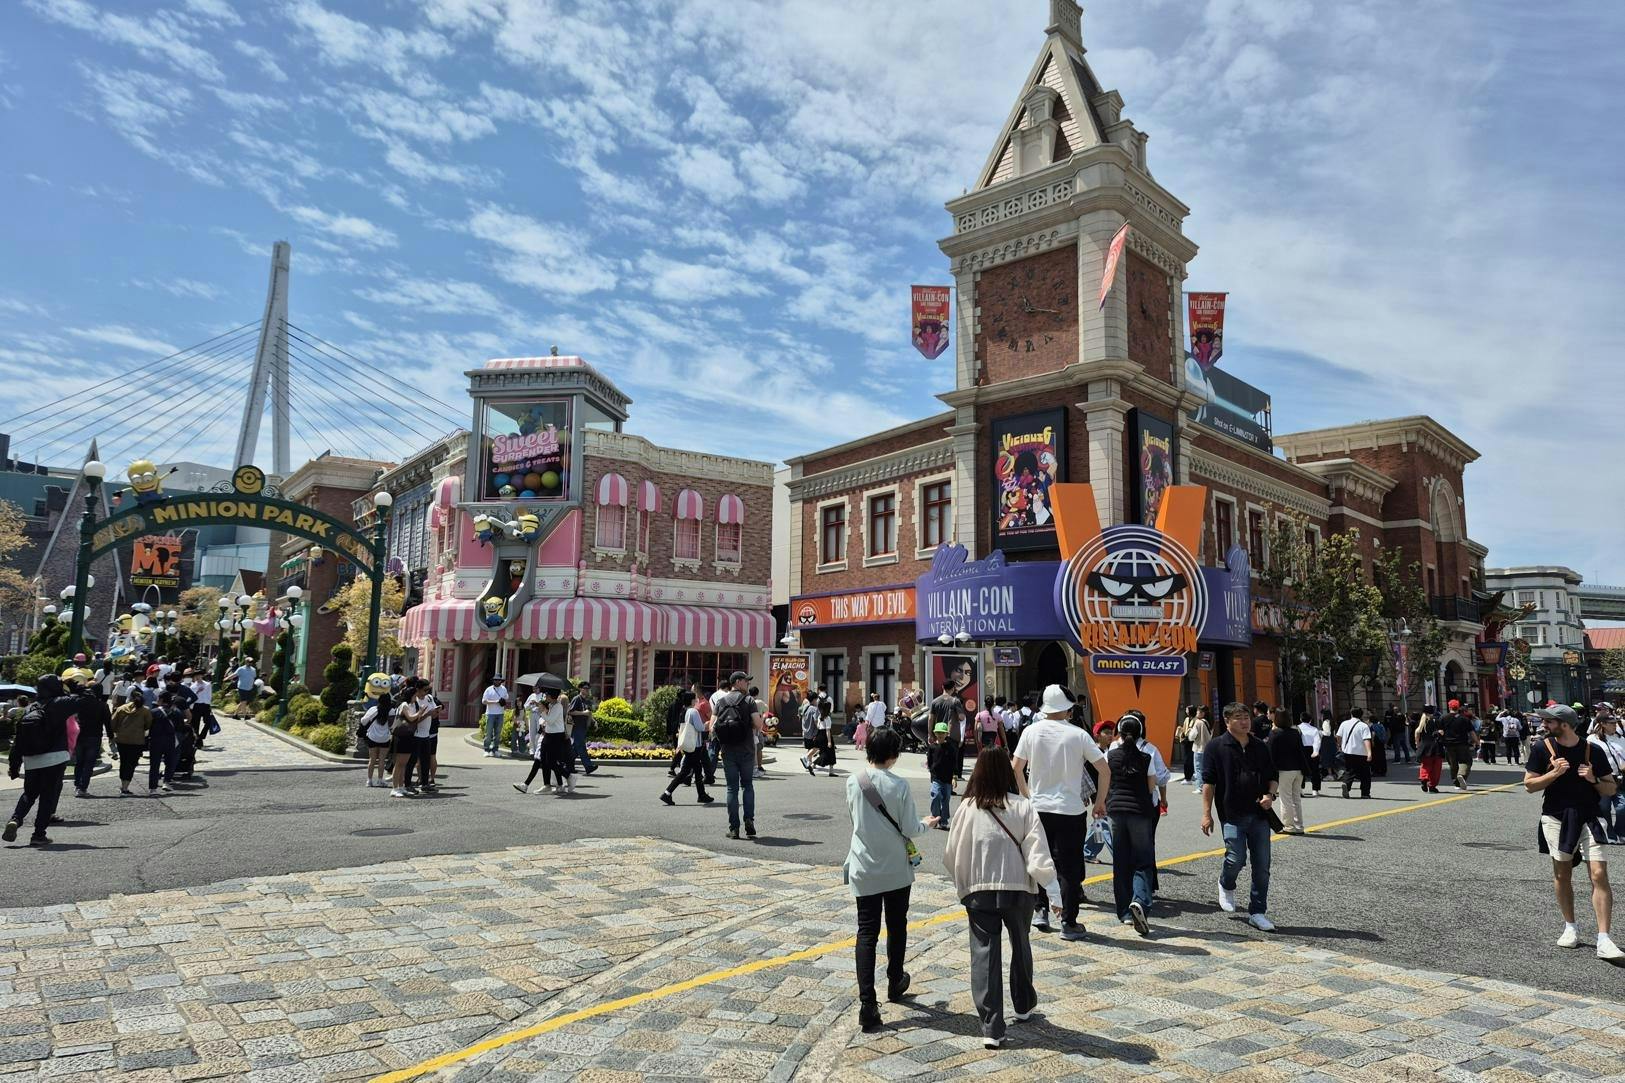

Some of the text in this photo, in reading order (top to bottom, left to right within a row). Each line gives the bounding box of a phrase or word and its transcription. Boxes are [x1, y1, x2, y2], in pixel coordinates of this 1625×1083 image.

[912, 293, 949, 302] VILLAIN-CON
[1190, 300, 1224, 310] VILLAIN-CON
[492, 424, 559, 454] Sweet
[492, 444, 560, 463] SURRENDER
[492, 464, 524, 472] CANDIES
[532, 456, 560, 466] TREATS
[153, 501, 332, 537] MINION PARK
[830, 592, 907, 619] THIS WAY TO EVIL
[928, 586, 1014, 618] VILLAIN-CON
[1080, 622, 1197, 653] VILLAIN-CON
[1142, 661, 1179, 670] BLAST
